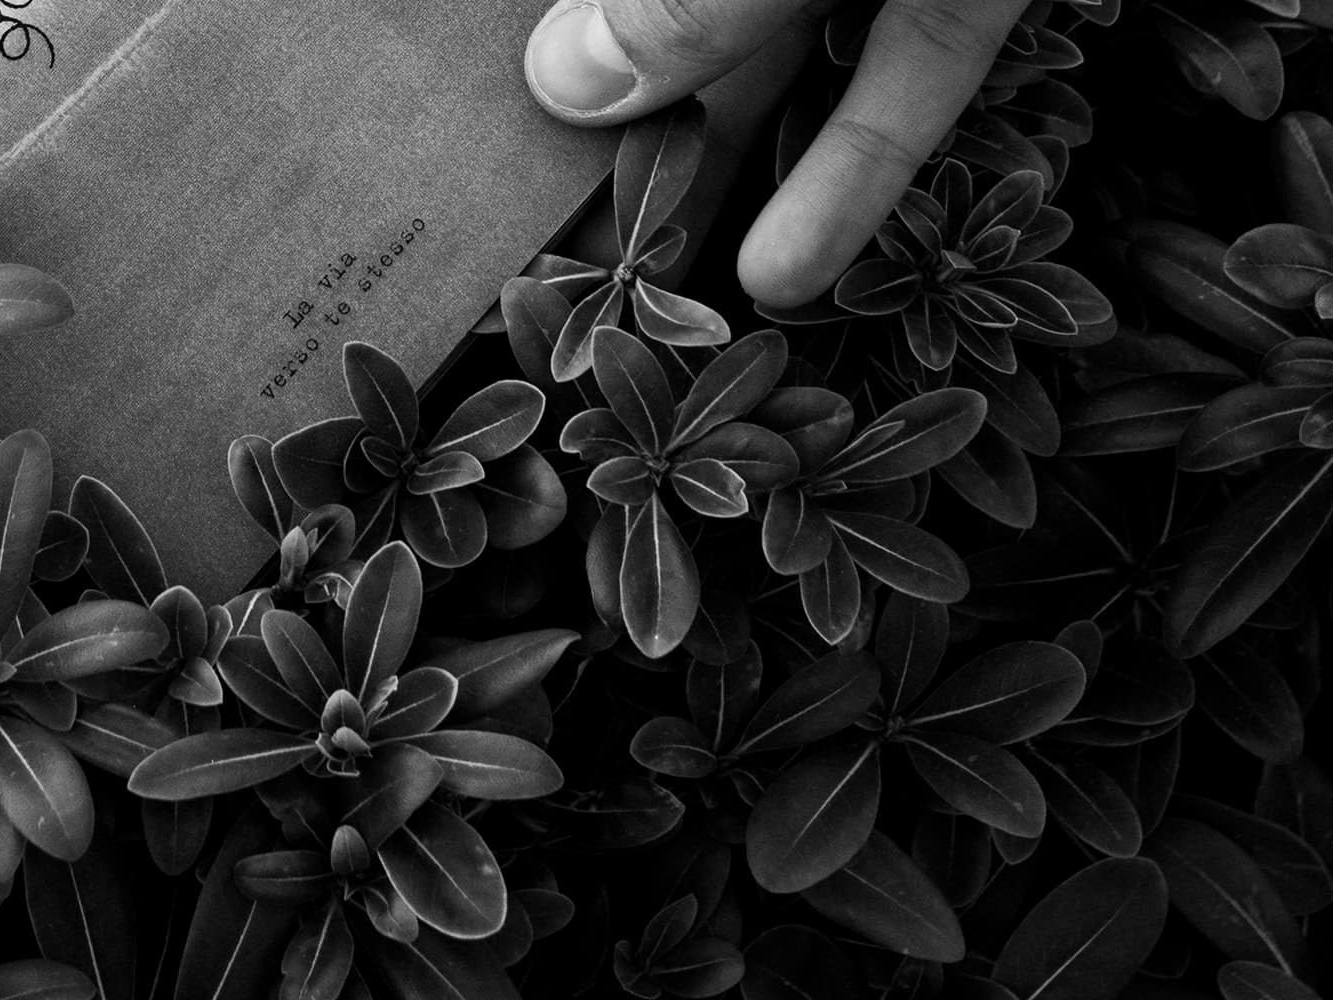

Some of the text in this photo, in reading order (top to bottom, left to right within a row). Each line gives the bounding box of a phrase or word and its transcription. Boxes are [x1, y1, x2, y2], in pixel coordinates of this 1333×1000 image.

[260, 218, 426, 400] verso te stesso
[282, 252, 358, 329] La via
